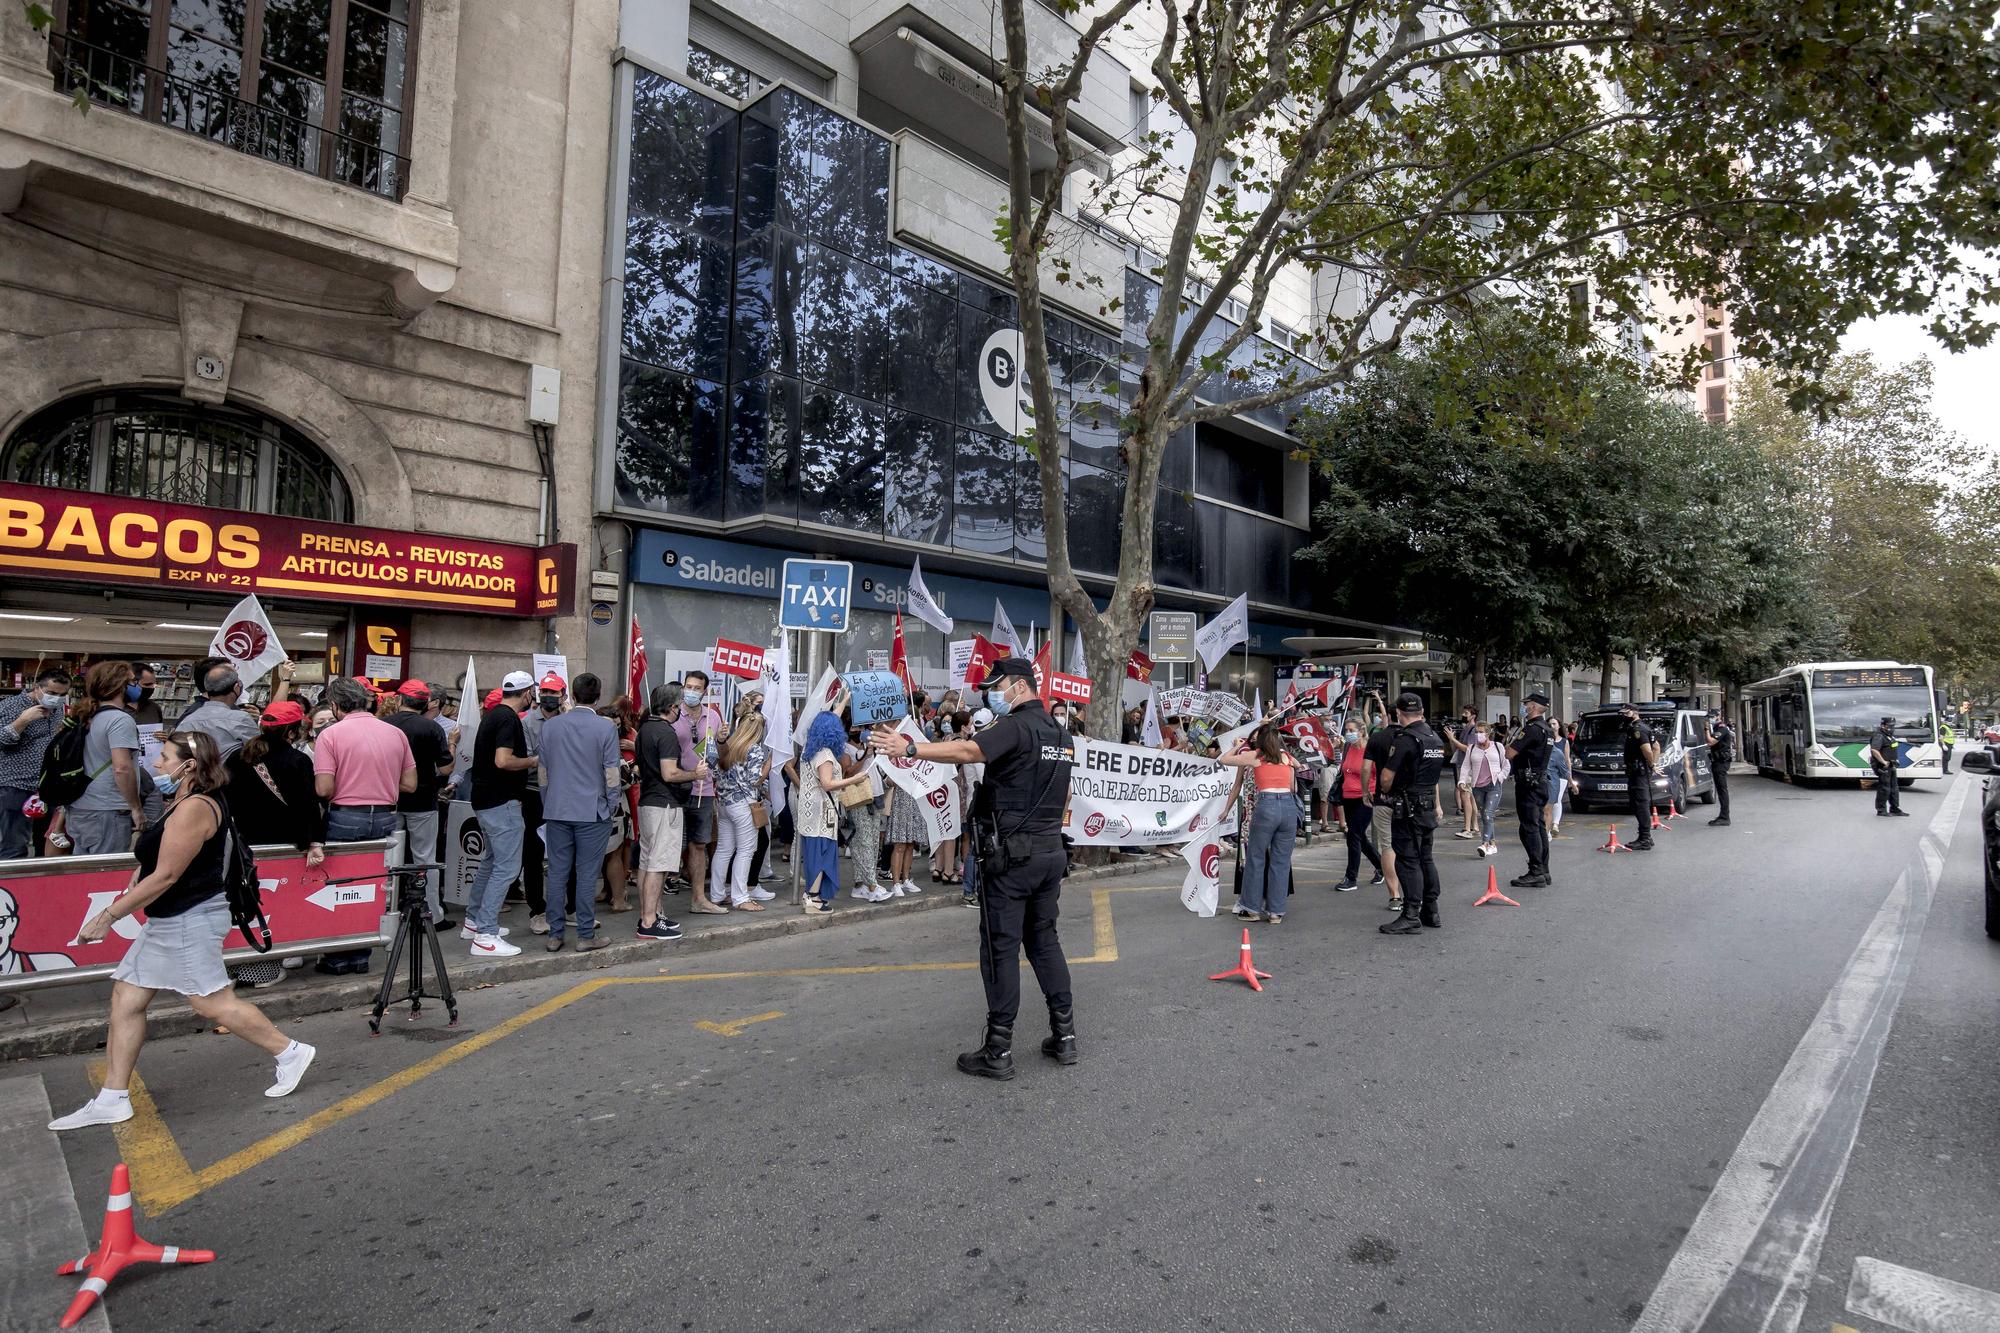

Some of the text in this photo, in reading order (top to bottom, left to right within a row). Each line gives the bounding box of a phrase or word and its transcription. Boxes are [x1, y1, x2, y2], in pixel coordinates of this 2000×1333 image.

[206, 362, 214, 375] 9
[300, 532, 390, 559] PRENSA
[410, 545, 504, 570] REVISTAS
[168, 569, 202, 582] EXP
[230, 574, 251, 586] 22
[281, 555, 516, 593] ARTICULOS FUMADOR
[678, 555, 776, 590] Sabadell
[786, 584, 847, 608] TAXI
[874, 582, 945, 611] Sabll
[715, 646, 762, 672] CCOO
[852, 671, 880, 685] En el
[1051, 677, 1091, 698] CCOO
[871, 706, 894, 720] UNO
[1086, 749, 1122, 773] ERE
[334, 889, 362, 902] 1 min.
